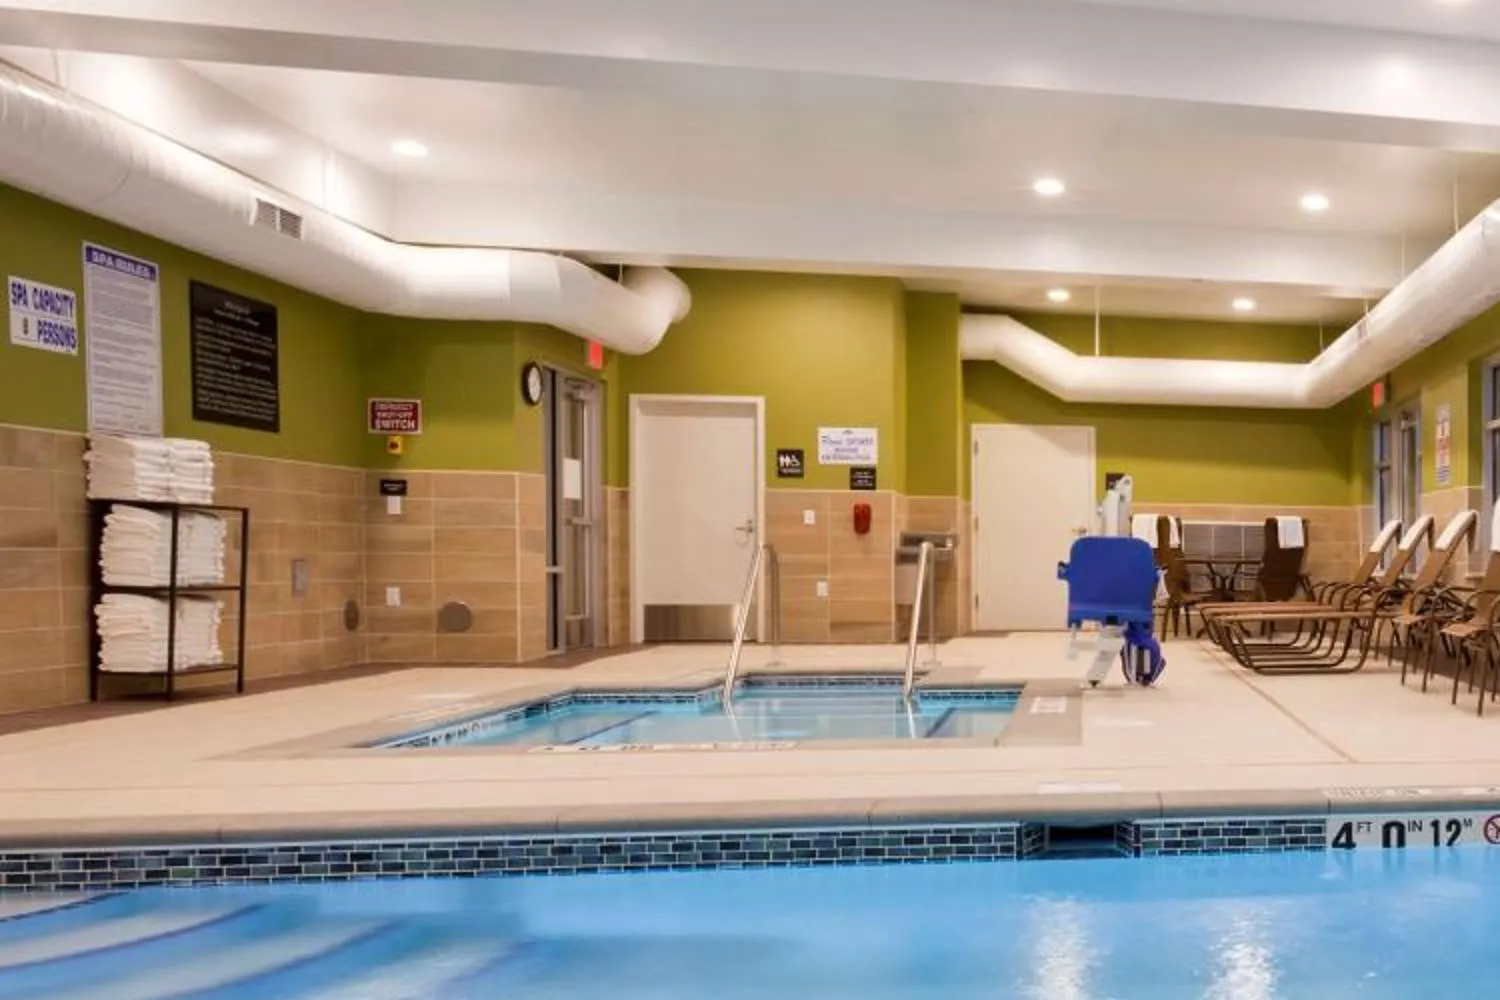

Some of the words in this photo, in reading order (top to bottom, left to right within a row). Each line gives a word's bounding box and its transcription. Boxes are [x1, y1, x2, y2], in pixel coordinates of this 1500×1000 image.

[11, 281, 29, 307] SPA
[32, 287, 75, 318] CAPACITY
[37, 319, 76, 350] PERSONS
